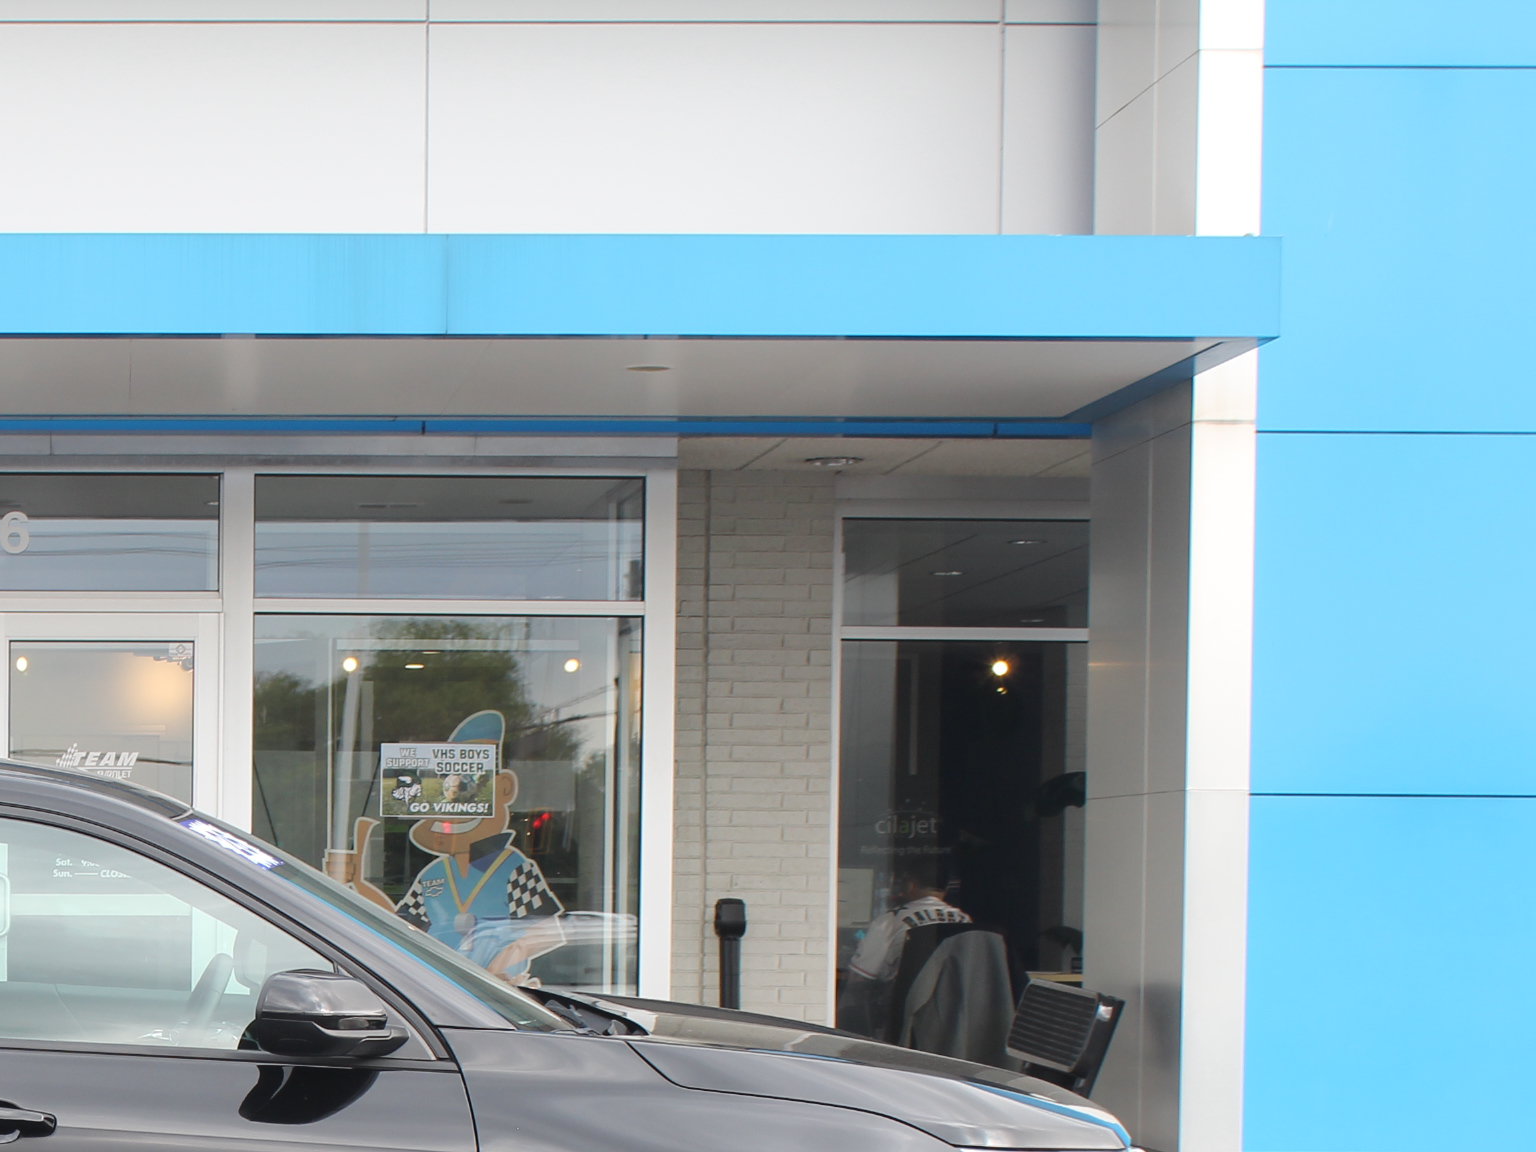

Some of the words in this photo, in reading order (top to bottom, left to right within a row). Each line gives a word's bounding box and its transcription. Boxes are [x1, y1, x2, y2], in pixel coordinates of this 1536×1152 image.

[400, 748, 416, 757] WE
[432, 749, 455, 759] VHS
[460, 749, 490, 759] BOYS
[72, 751, 139, 767] TEAM
[386, 758, 430, 767] SUPPORT
[436, 762, 484, 773] SOCCER
[409, 802, 430, 812] GO
[433, 802, 489, 813] VIKINGS!
[875, 814, 937, 839] cilajet
[55, 858, 73, 866] Sat.
[52, 869, 73, 878] Sun.
[100, 869, 132, 878] CLOS
[422, 878, 445, 887] TEAM
